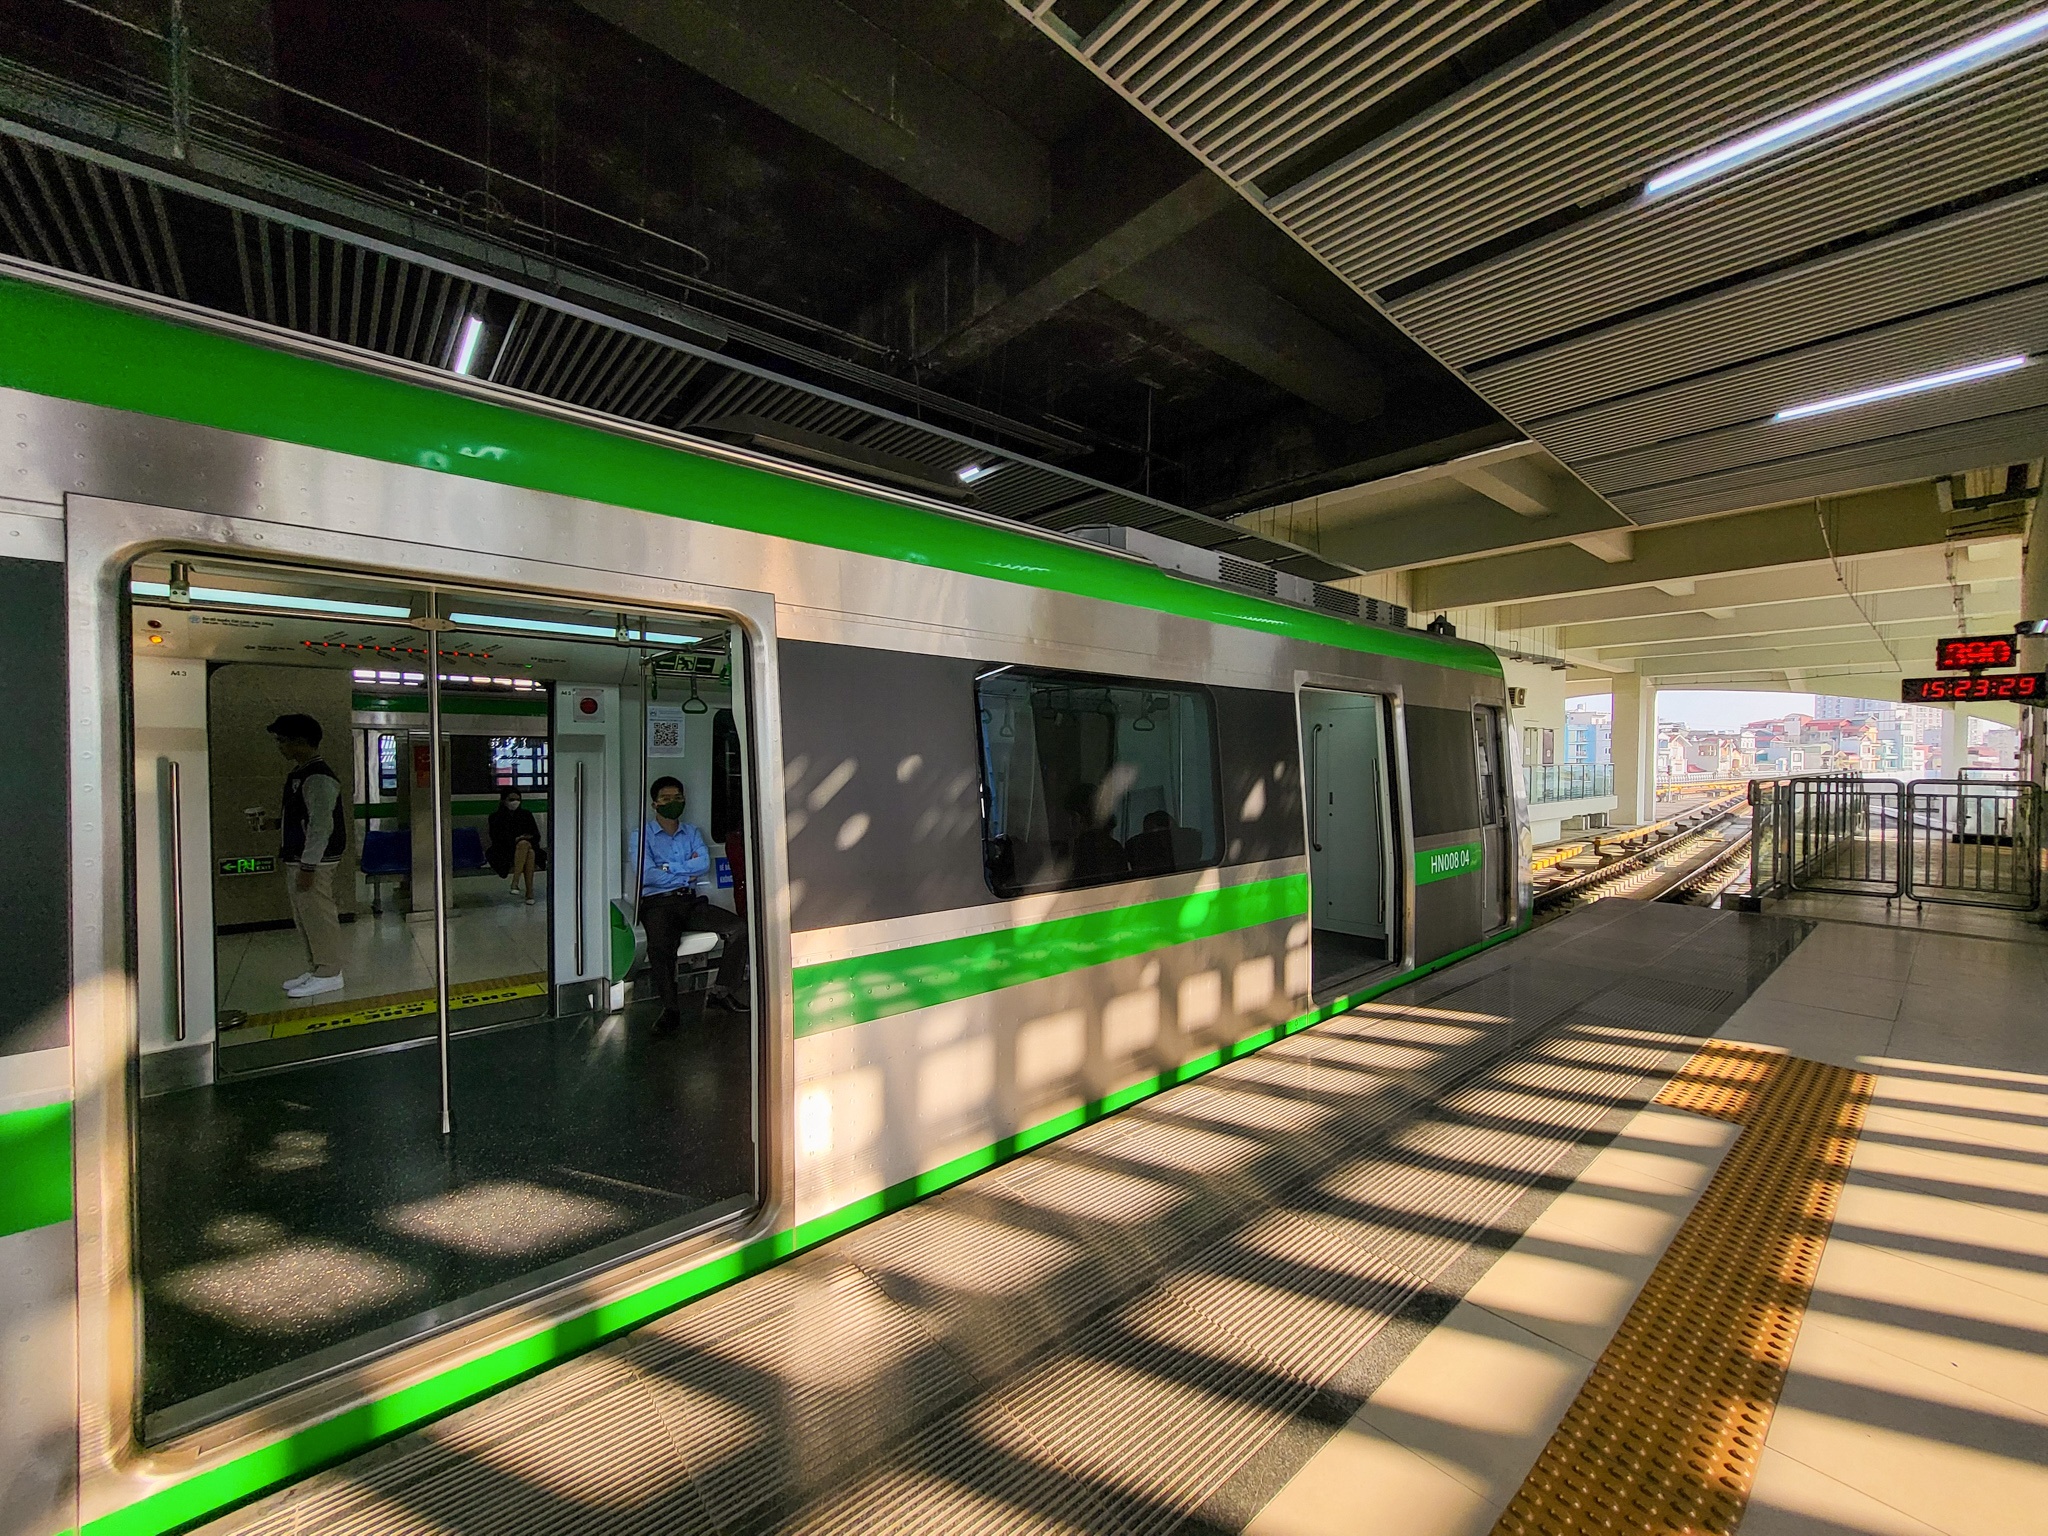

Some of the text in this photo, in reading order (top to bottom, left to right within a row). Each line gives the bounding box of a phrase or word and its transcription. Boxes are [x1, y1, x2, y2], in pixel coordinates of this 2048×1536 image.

[1922, 677, 2036, 698] 15:23:29
[1431, 849, 1470, 874] HN008 04
